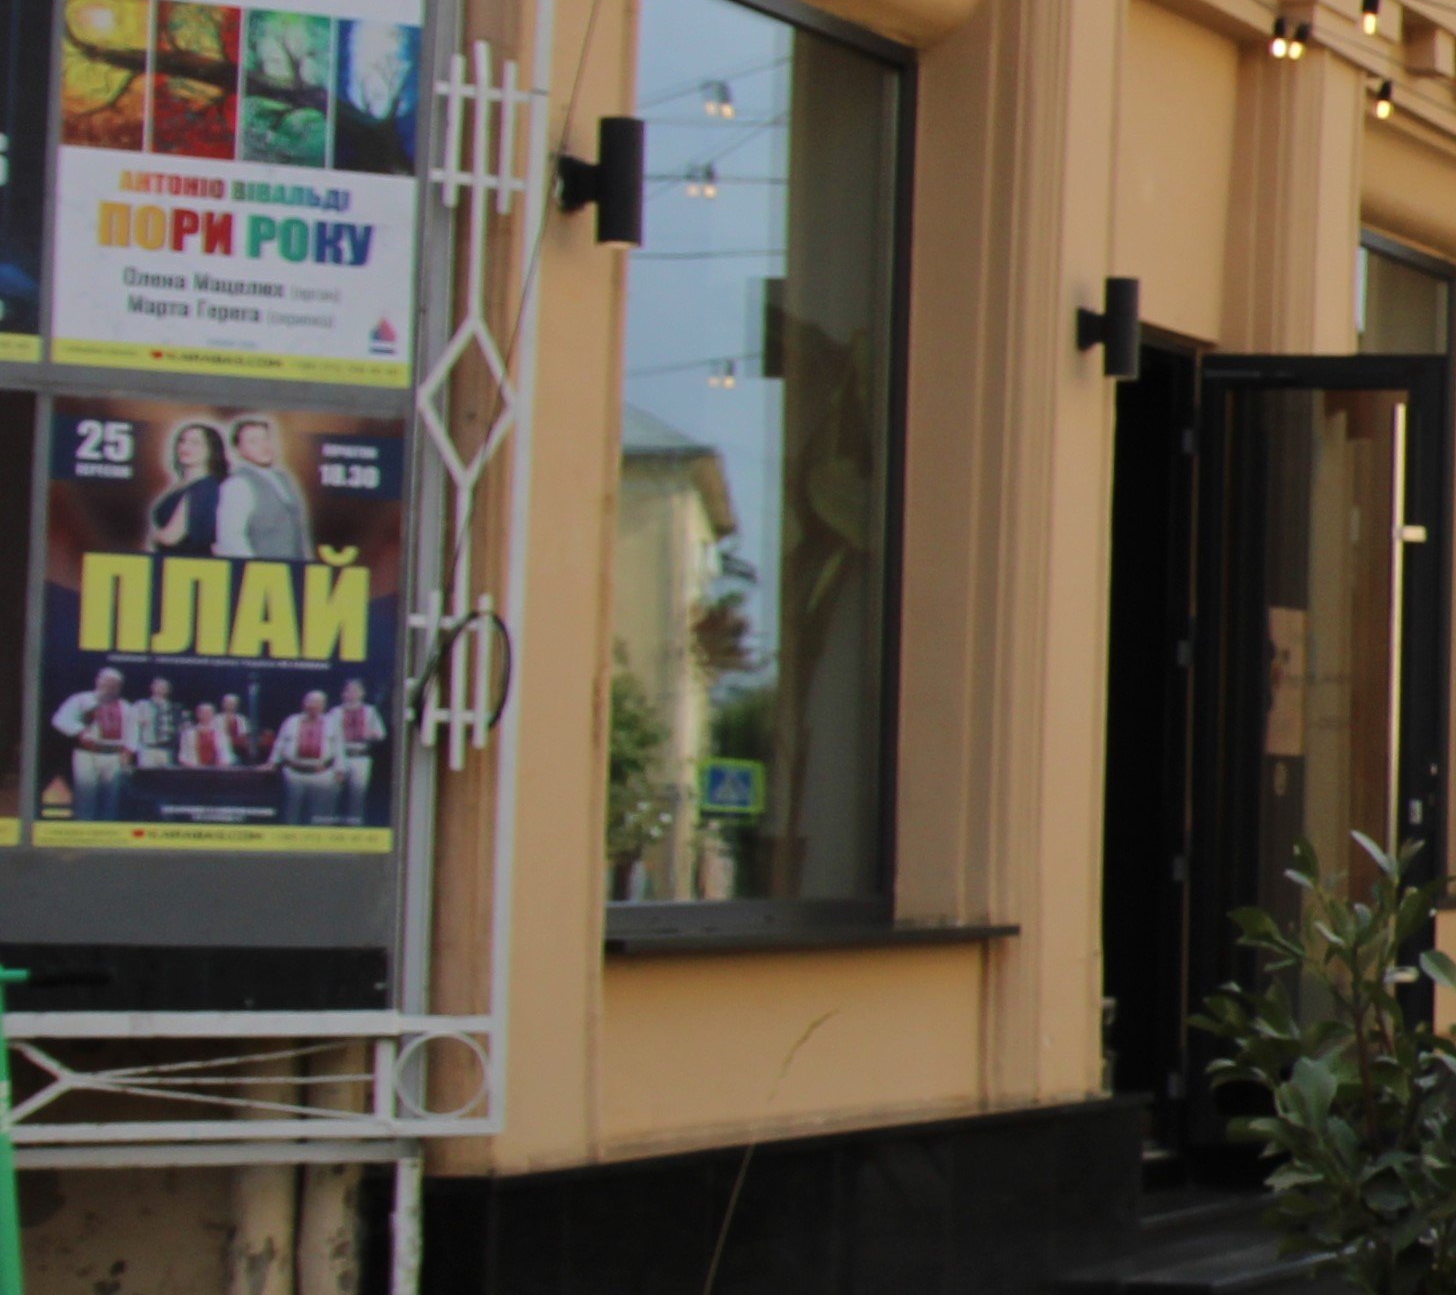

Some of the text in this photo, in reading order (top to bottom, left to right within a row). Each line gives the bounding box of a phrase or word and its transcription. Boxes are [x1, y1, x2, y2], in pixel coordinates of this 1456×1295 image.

[119, 170, 351, 213] АНТОНІО ВІВАЛЬДІ
[97, 201, 374, 266] ПОРИ РОКУ
[123, 266, 186, 291] Олена
[127, 293, 189, 318] Марта
[76, 419, 134, 463] 25
[78, 544, 371, 662] ПЛАЙ
